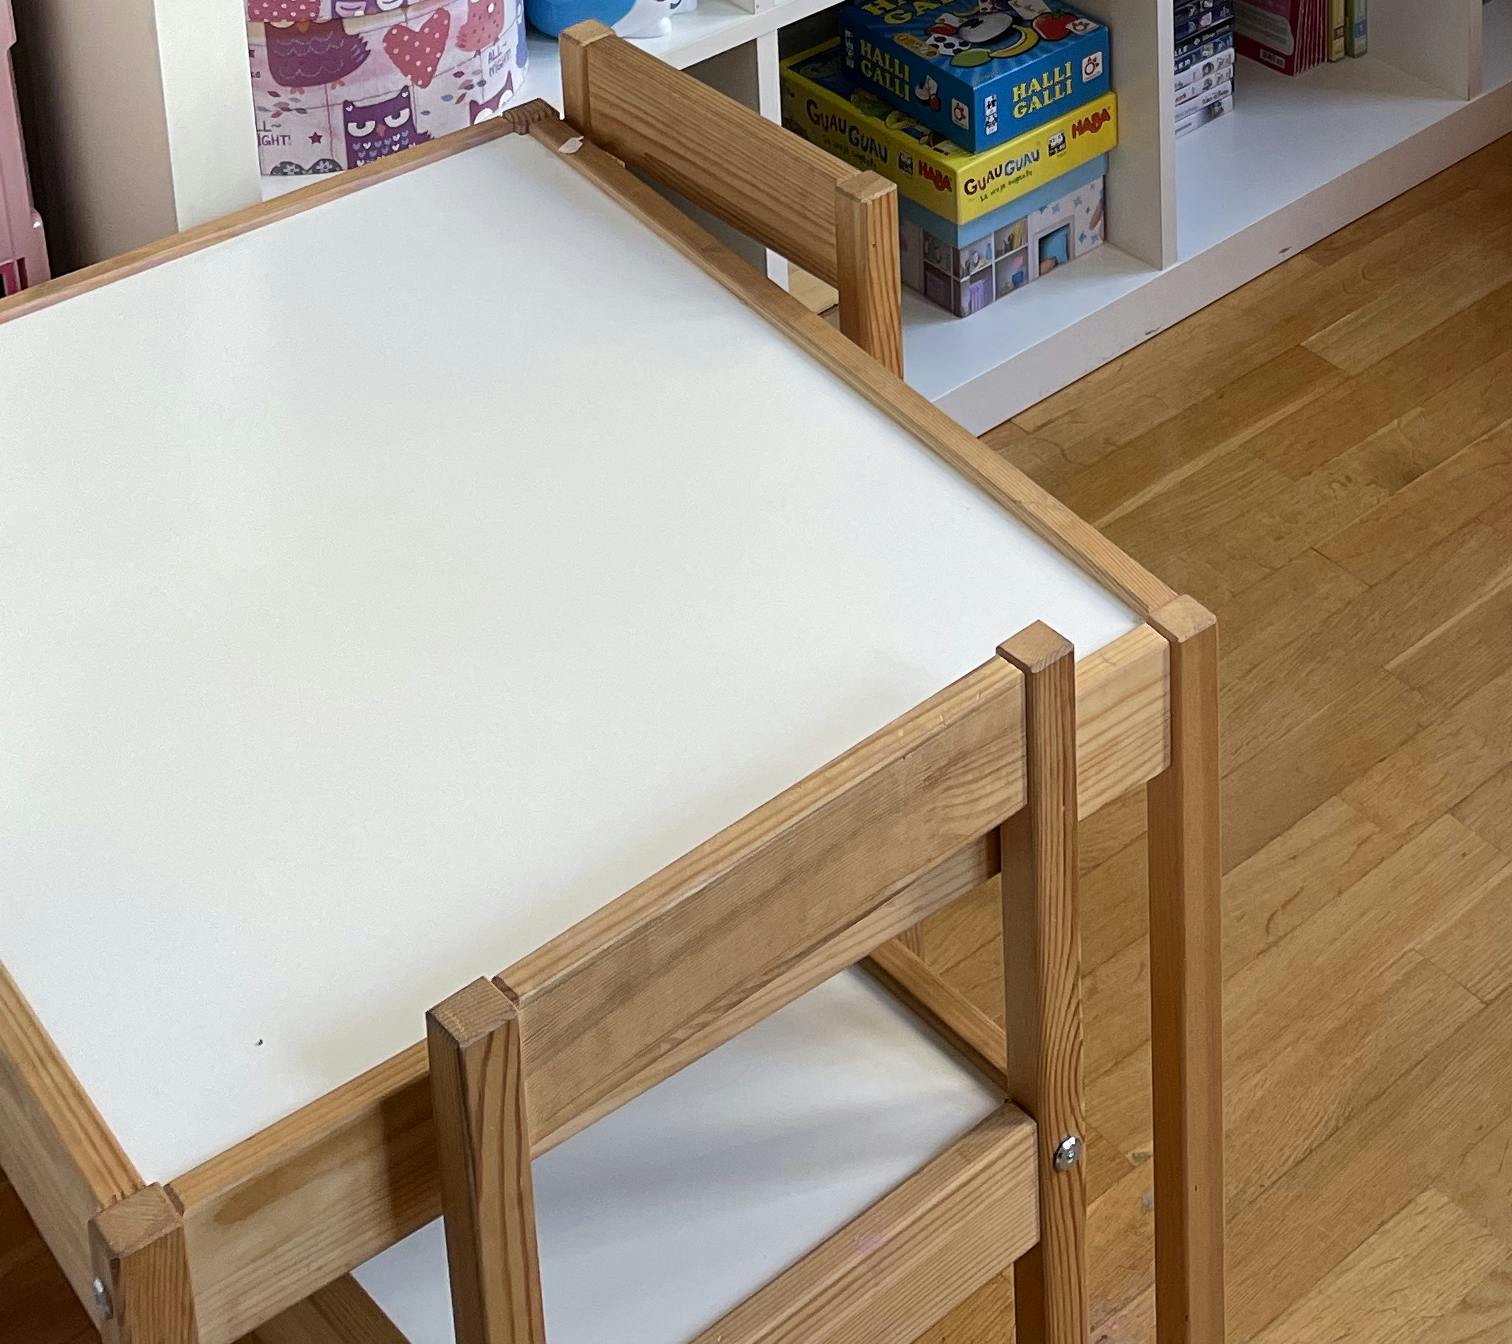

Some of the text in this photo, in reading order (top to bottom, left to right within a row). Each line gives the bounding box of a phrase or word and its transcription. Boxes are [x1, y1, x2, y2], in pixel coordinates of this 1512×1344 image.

[859, 38, 911, 83] HALLI
[859, 60, 911, 103] GALLI
[1012, 61, 1073, 102] HALLI
[1012, 79, 1074, 120] GALLI
[806, 98, 889, 163] GUAU GUAU
[1070, 107, 1112, 142] HABA
[917, 159, 954, 193] HABA
[963, 163, 1004, 197] GUAU
[1004, 149, 1041, 177] GUAU
